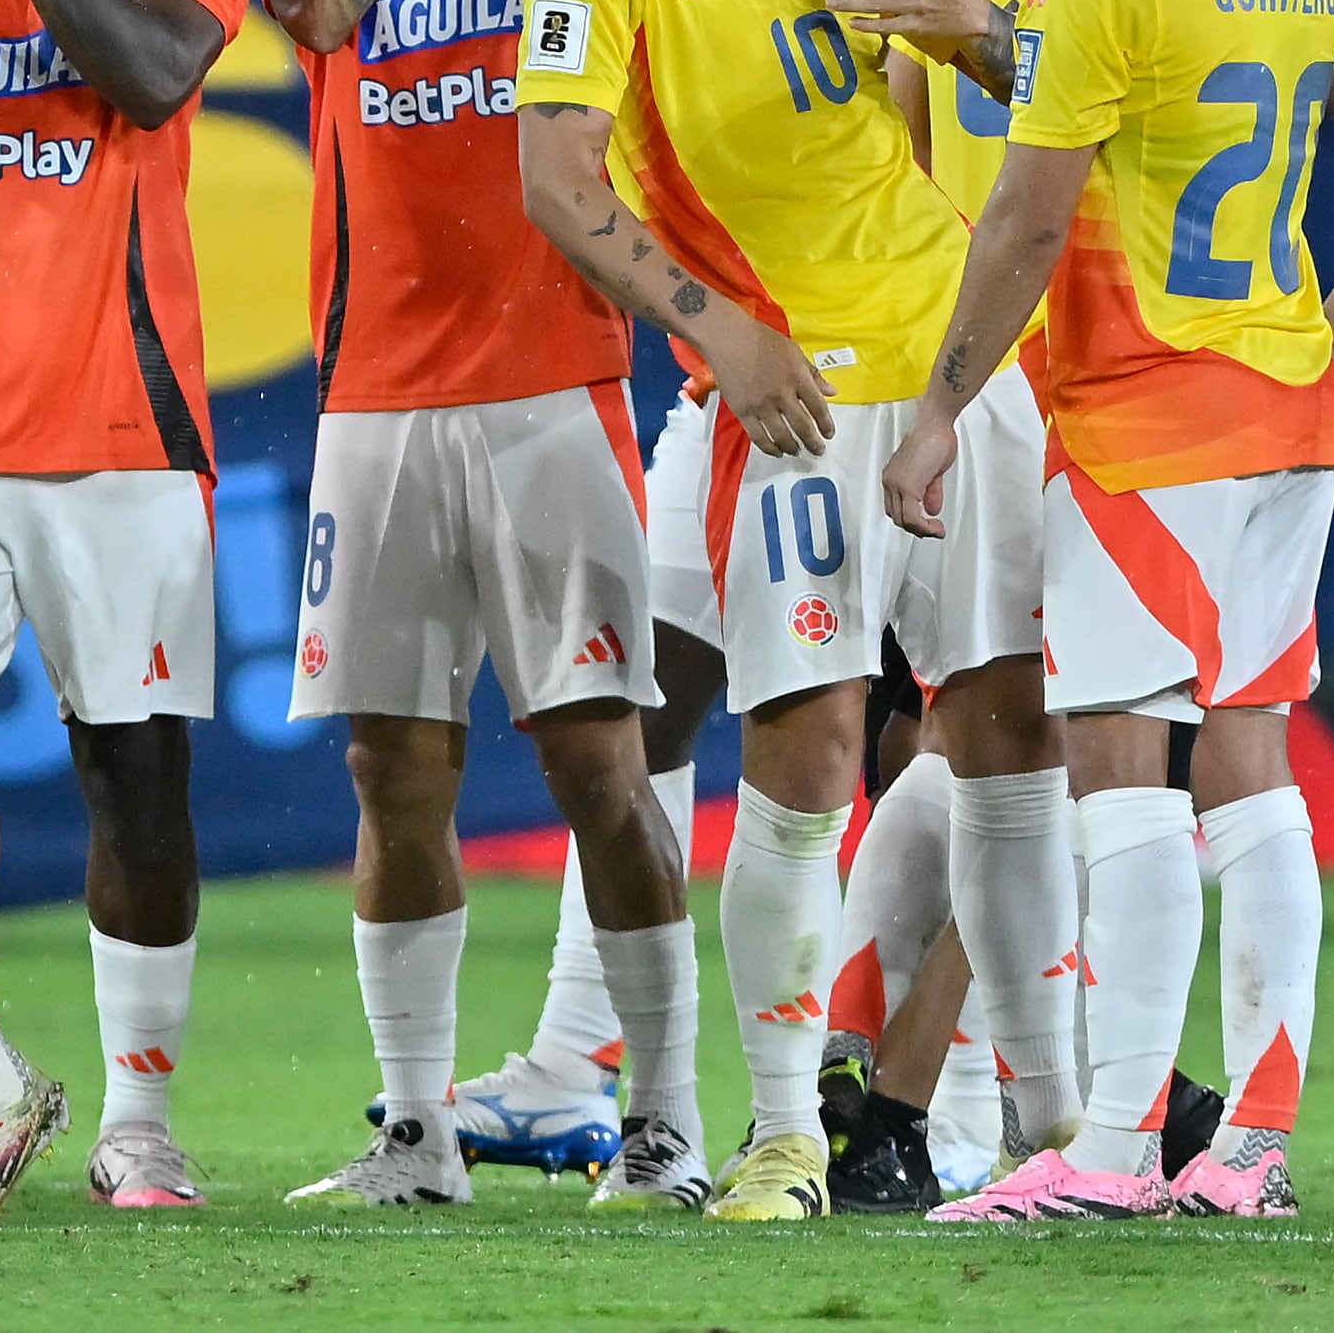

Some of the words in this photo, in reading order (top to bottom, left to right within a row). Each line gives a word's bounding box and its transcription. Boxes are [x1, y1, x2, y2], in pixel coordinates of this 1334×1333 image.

[359, 67, 516, 125] BetPla
[771, 9, 858, 113] 10
[306, 511, 336, 608] 8
[761, 476, 846, 584] 10
